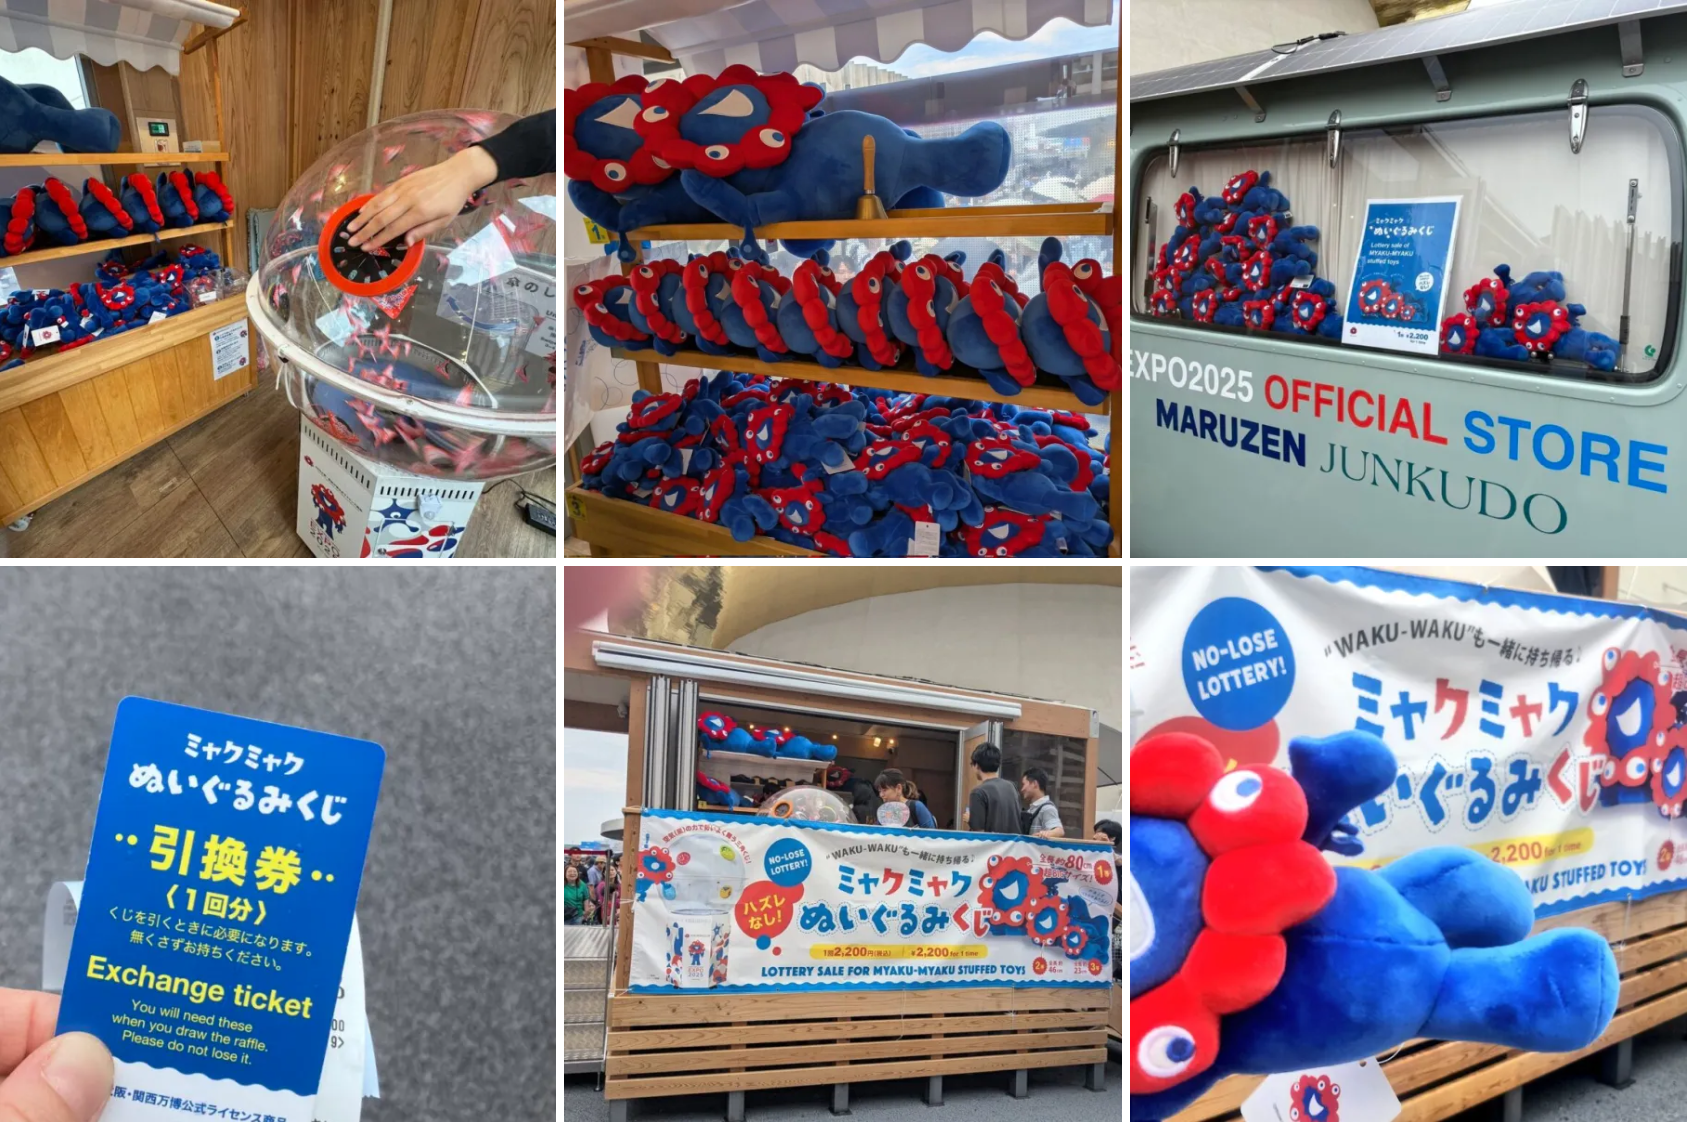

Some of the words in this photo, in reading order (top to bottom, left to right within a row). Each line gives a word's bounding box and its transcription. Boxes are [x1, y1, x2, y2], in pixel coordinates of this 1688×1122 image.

[1373, 225, 1434, 236] ぬいぐるみくじ
[1264, 374, 1449, 446] OFFICIAL
[1463, 410, 1668, 494] STORE
[1156, 398, 1306, 467] MARUZEN
[1319, 442, 1568, 534] JUNKUDO
[1191, 628, 1279, 671] NO-LOSE
[1196, 656, 1288, 701] LOTTERY!
[1351, 671, 1580, 741] ミャクミャク
[184, 732, 304, 776] ミャクミャク
[129, 763, 348, 825] ぬいぐるみくじ
[1357, 747, 1607, 828] いぐるみくじ
[149, 824, 302, 894] 引換券
[768, 849, 806, 866] NO-LOSE
[770, 859, 809, 876] LOTTERY!
[1486, 841, 1543, 865] 2,200
[838, 864, 973, 898] ミャクミャク
[1552, 861, 1606, 890] STUFFED
[743, 894, 786, 916] ハズレ
[748, 909, 782, 930] なし!
[799, 902, 992, 938] ぬいぐるみくじ
[108, 906, 312, 957] くじを引くときに必要になります。
[130, 929, 282, 971] 無くさずお持ちください。
[761, 966, 814, 977] LOTTERY
[817, 966, 845, 977] SALE
[847, 966, 870, 976] FOR
[873, 965, 956, 976] MYAKU-MYAKU
[957, 964, 997, 975] STUFFED
[1000, 965, 1026, 975] TOYS
[911, 947, 950, 959] ¥2,200
[86, 954, 225, 1004] Exchange
[233, 984, 313, 1019] ticket
[112, 1013, 145, 1029] when
[149, 1021, 172, 1035] you
[175, 1024, 207, 1040] draw
[211, 1031, 231, 1045] the
[233, 1035, 268, 1052] raffle.
[131, 999, 155, 1014] You
[160, 1005, 180, 1019] will
[183, 1009, 214, 1026] need
[218, 1017, 253, 1033] these
[122, 1030, 164, 1049] Please
[167, 1038, 184, 1052] do
[187, 1043, 208, 1056] not
[211, 1047, 237, 1062] lose
[240, 1053, 252, 1065] it.
[110, 1085, 287, 1122] 阪・関西万博公式ライセンス商品
